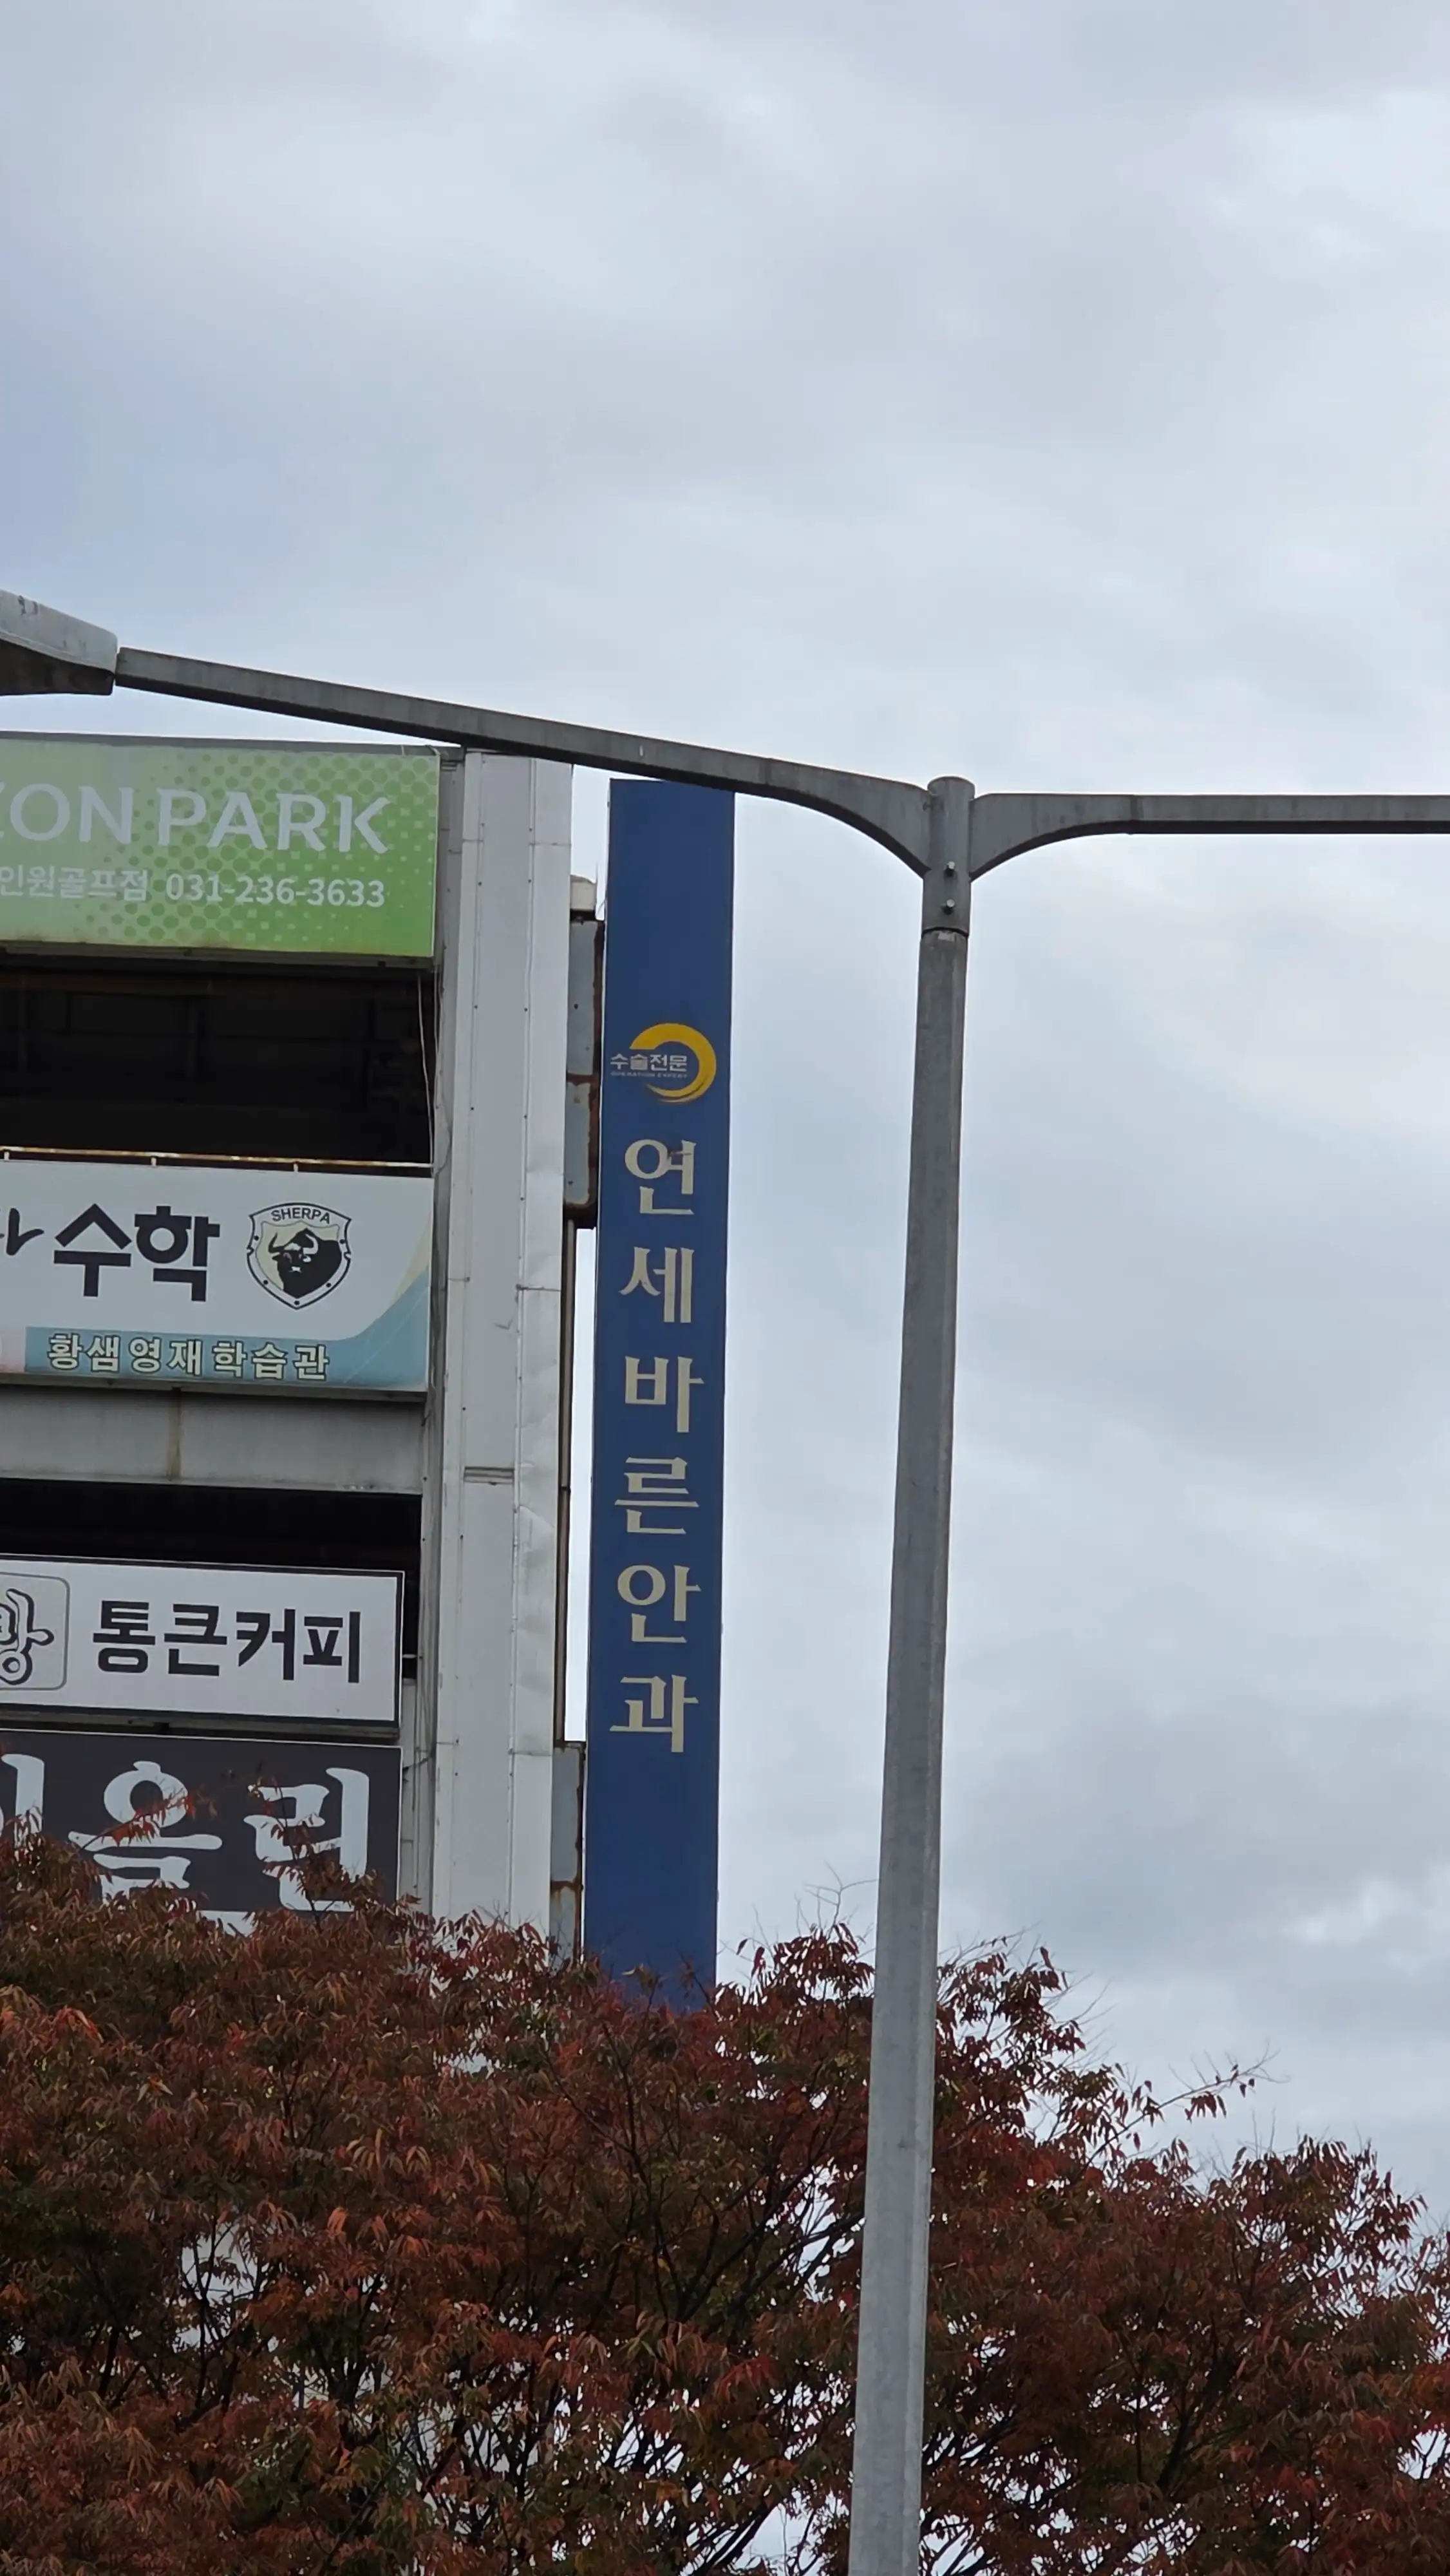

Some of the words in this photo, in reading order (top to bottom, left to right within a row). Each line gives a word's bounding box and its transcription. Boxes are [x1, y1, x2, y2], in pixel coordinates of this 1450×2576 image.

[0, 782, 134, 845] ON
[156, 788, 389, 854] PARK
[165, 872, 385, 908] 031-236-3633
[271, 1207, 331, 1224] SHERPA
[609, 1138, 704, 1754] 연세바른안과
[93, 1600, 361, 1683] 통큰커피
